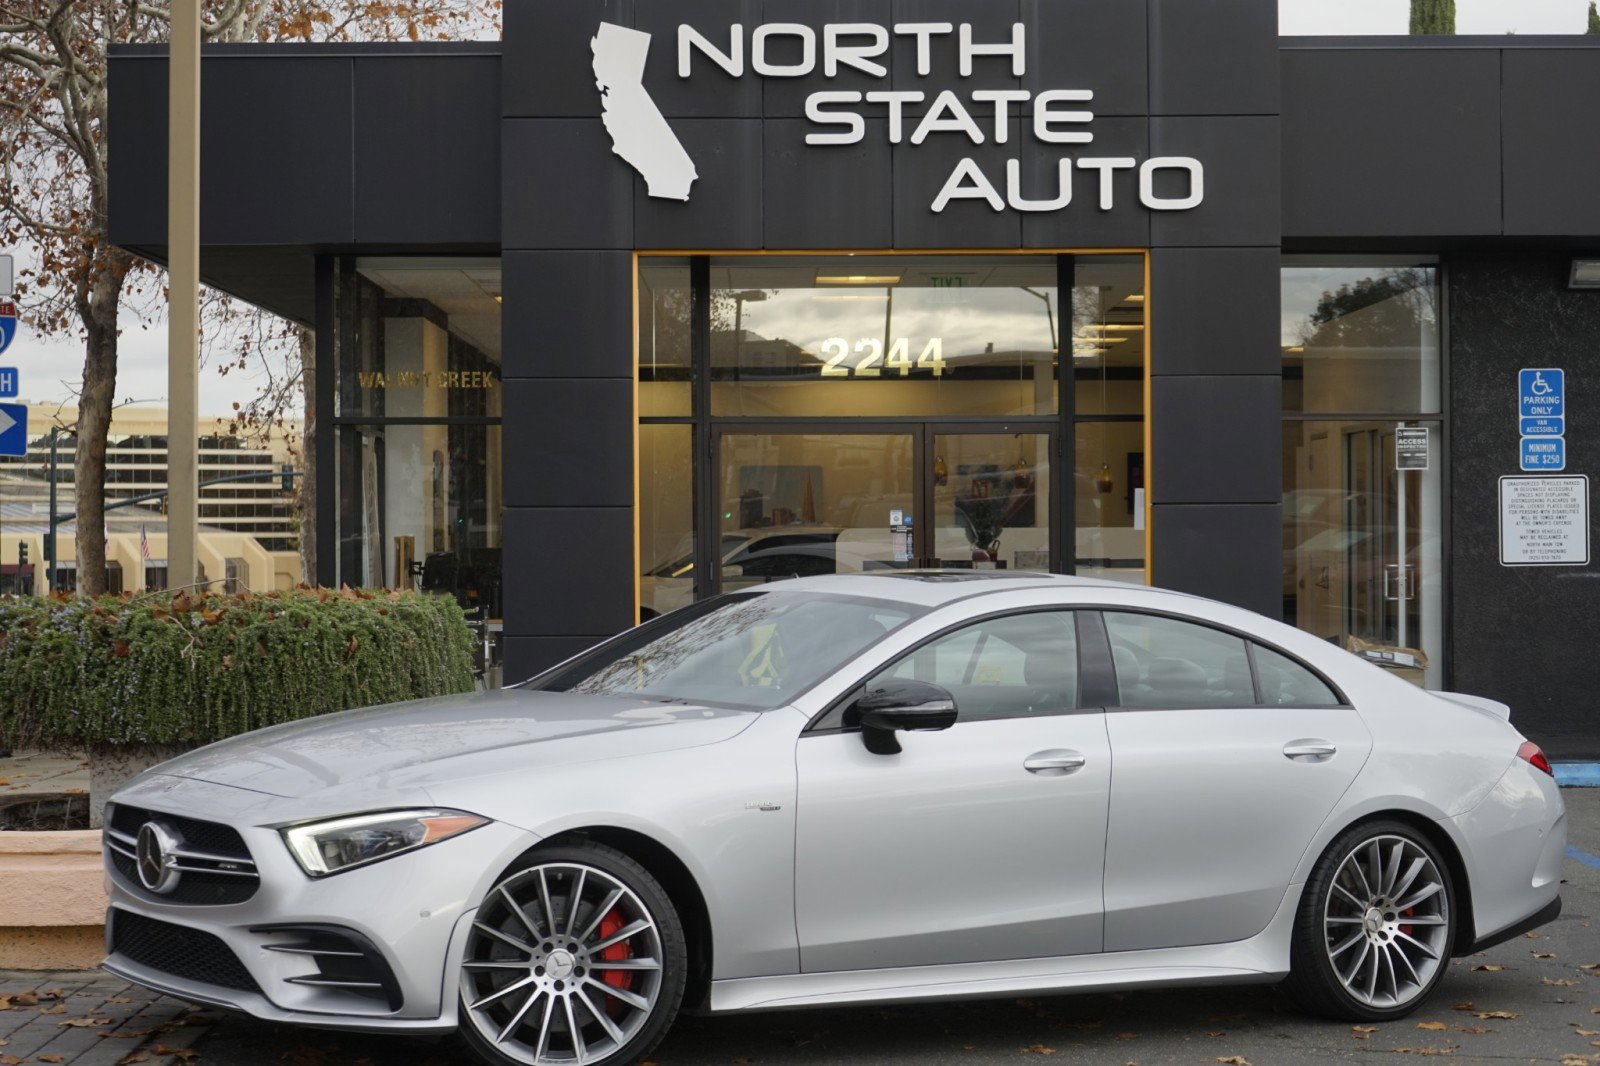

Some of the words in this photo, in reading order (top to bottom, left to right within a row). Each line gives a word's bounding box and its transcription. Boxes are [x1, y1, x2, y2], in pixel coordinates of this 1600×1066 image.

[678, 23, 1025, 77] NORTH
[805, 90, 1093, 144] STATE
[931, 157, 1203, 212] AUTO
[821, 337, 947, 376] 2244
[438, 371, 493, 388] CREEK
[1523, 396, 1560, 404] PARKING
[1531, 406, 1553, 415] ONLY
[1528, 443, 1557, 453] MINIMUM
[1525, 455, 1539, 464] FINE
[1542, 454, 1560, 465] $250
